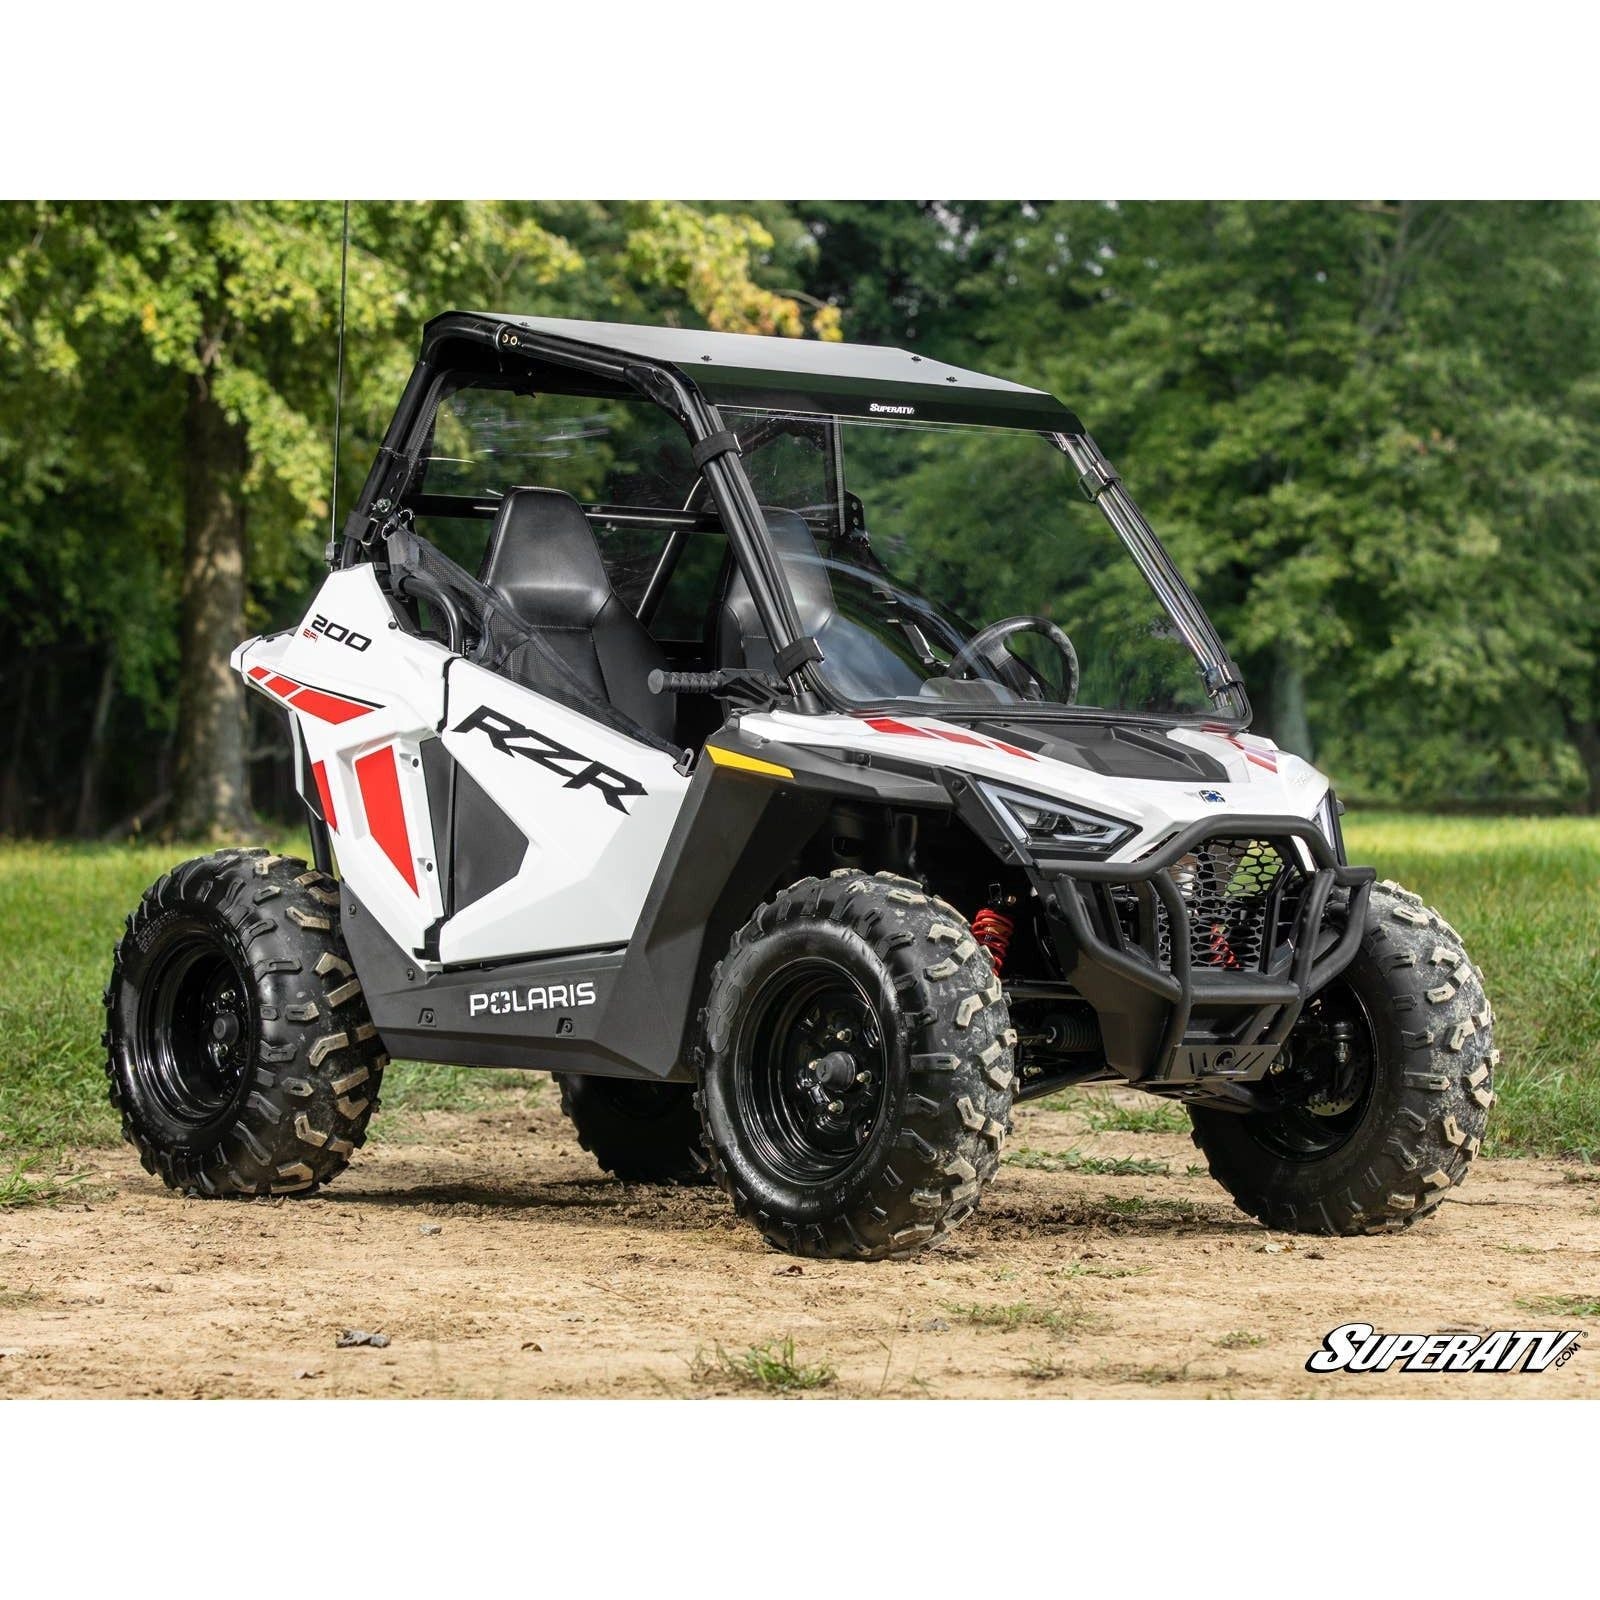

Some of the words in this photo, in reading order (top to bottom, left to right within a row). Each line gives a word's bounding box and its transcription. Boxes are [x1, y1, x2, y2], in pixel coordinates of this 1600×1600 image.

[311, 613, 372, 652] 200
[452, 705, 648, 815] RZR
[469, 982, 596, 1016] POLARIS
